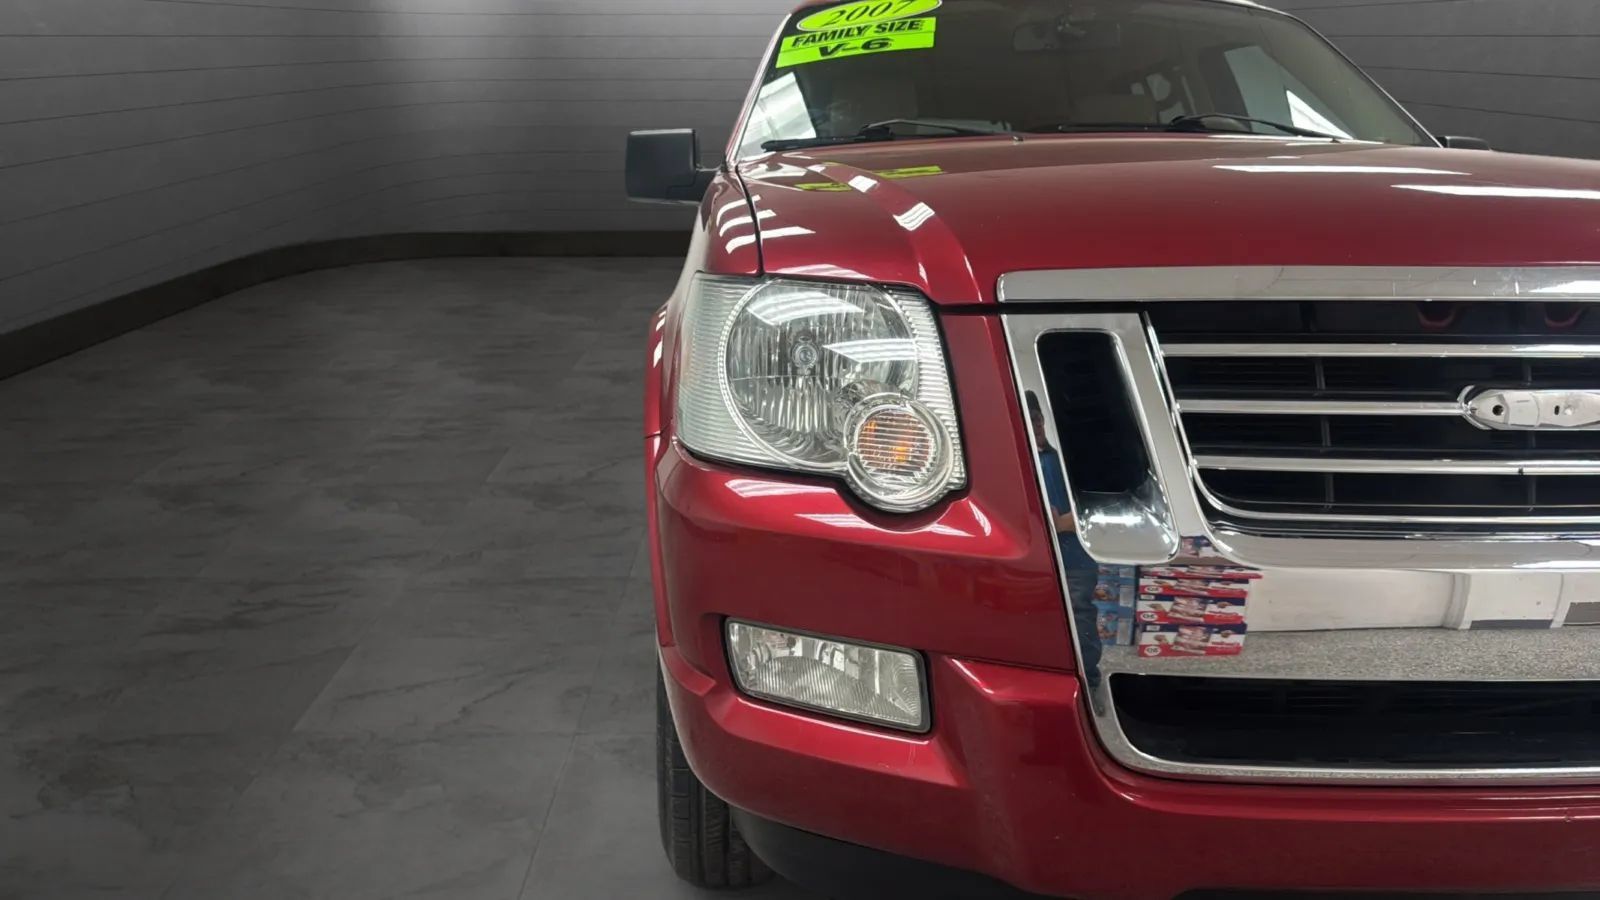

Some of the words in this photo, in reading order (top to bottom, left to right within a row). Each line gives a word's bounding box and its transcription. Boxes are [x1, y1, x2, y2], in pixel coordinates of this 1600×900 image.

[820, 0, 914, 27] 2007
[791, 25, 871, 47] FAMILY
[874, 19, 922, 33] SIZE
[819, 38, 893, 57] V-6
